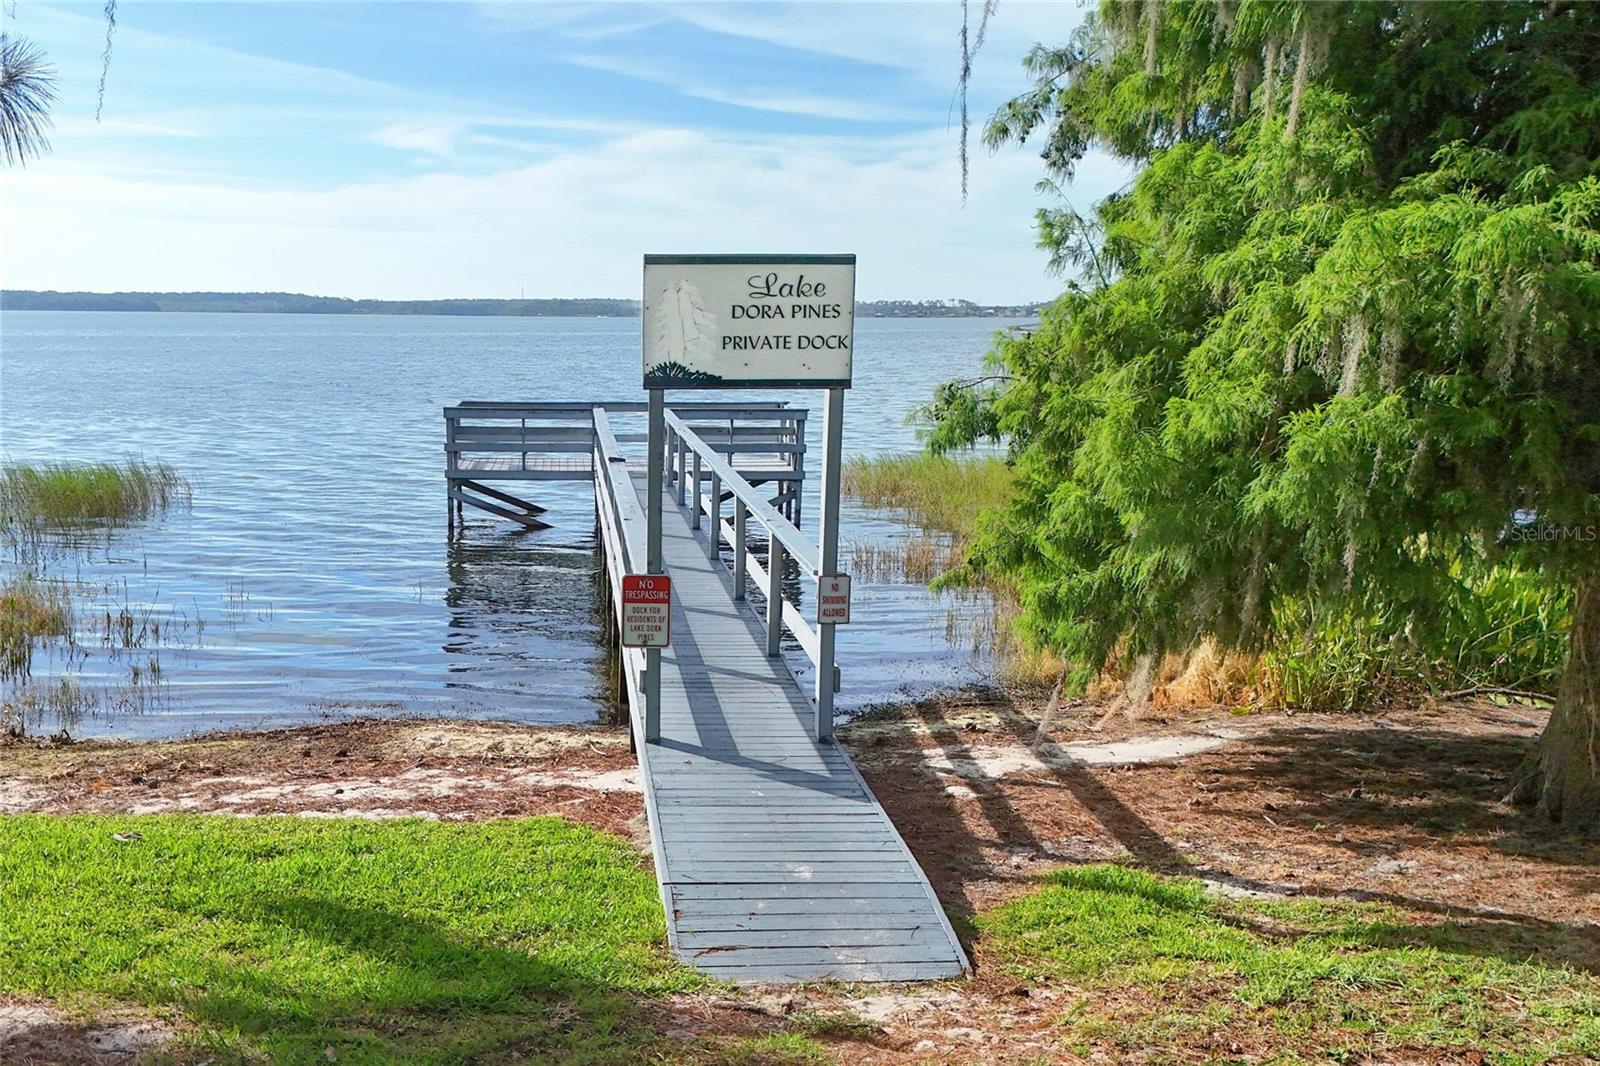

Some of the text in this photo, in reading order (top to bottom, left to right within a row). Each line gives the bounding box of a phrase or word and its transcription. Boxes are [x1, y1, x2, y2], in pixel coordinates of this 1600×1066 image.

[748, 272, 826, 299] Lake
[732, 304, 841, 319] DORA PINES
[722, 335, 849, 350] PRIVATE DOCK
[639, 580, 654, 589] NO
[831, 583, 838, 592] NO
[625, 590, 669, 600] TRESPASSING
[632, 606, 660, 614] DOCK FOR
[822, 608, 846, 617] ALLOWED
[627, 615, 657, 623] RESIDENTS
[630, 624, 662, 632] LAKE DORA
[637, 633, 654, 641] PINES
